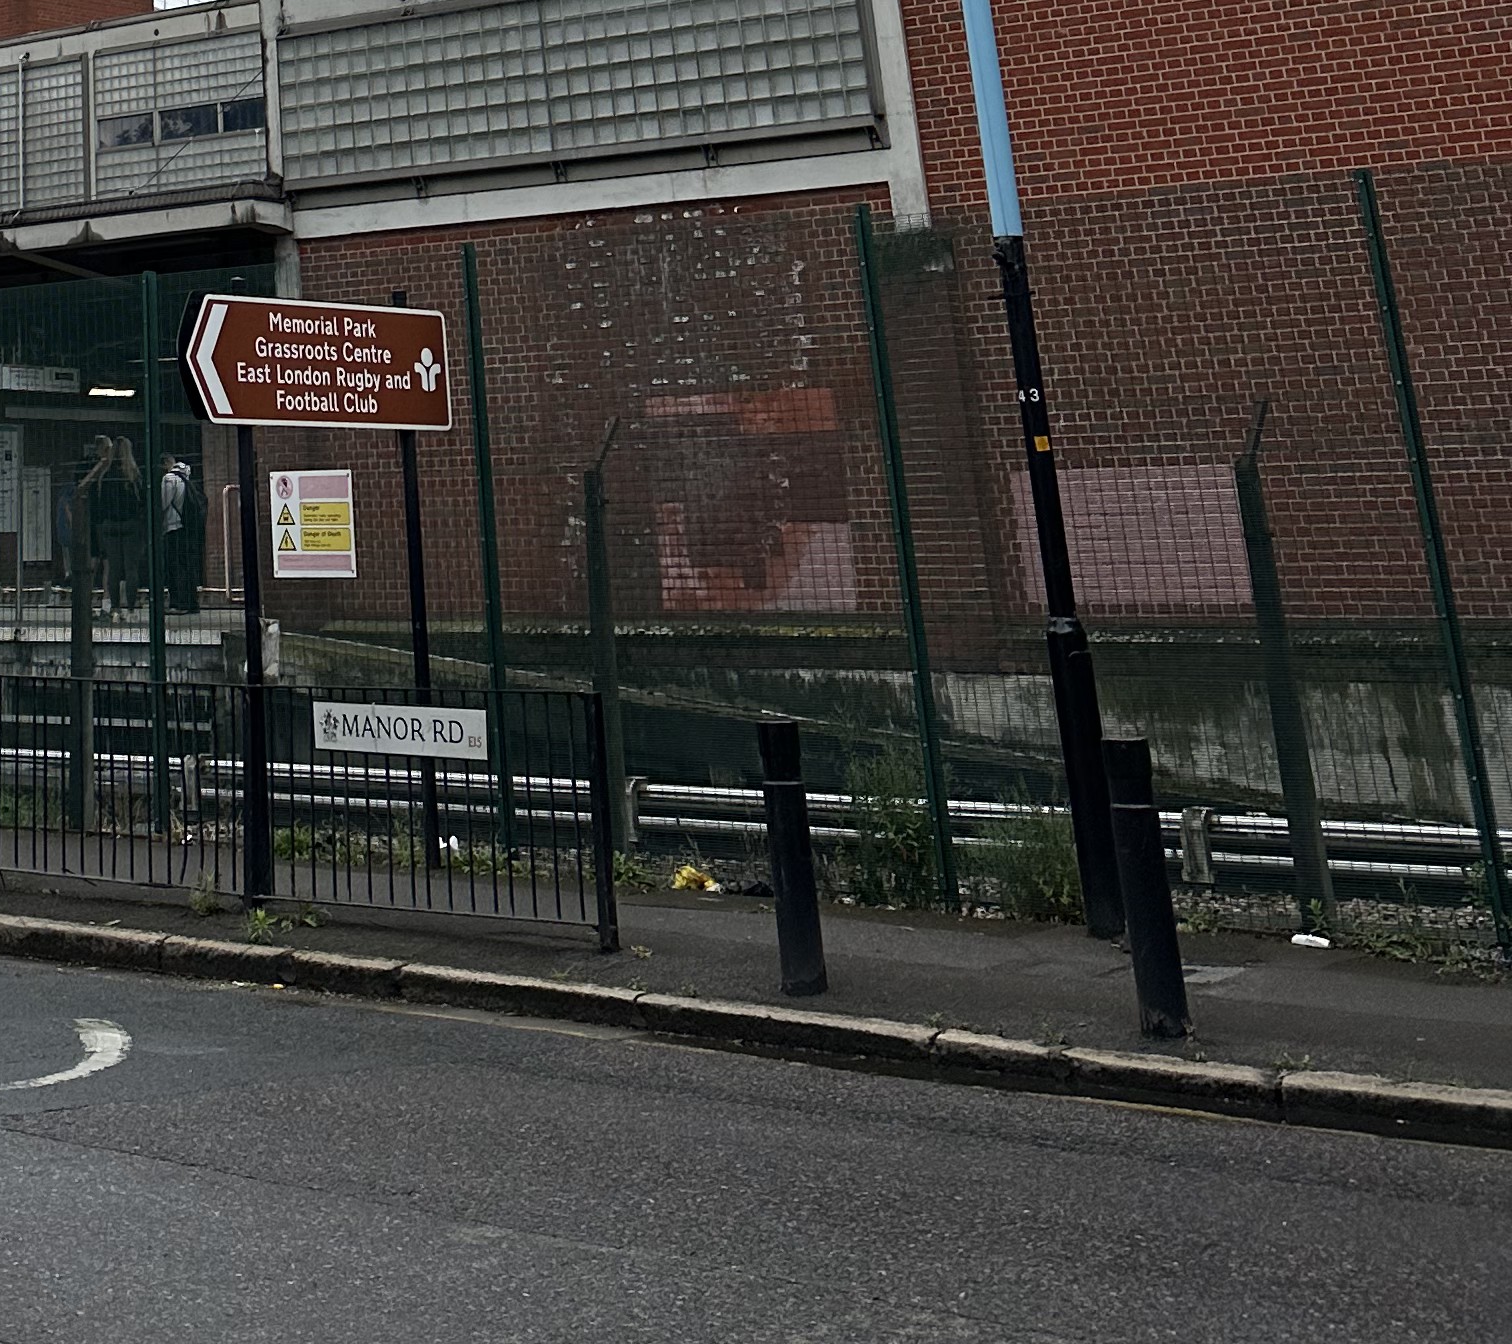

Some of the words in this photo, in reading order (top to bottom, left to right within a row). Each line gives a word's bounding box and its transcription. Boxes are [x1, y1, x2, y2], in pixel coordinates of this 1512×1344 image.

[269, 311, 340, 338] Memorial
[344, 317, 377, 339] Park
[255, 336, 338, 362] Grassroots
[342, 342, 392, 364] Centre
[236, 362, 271, 384] East
[276, 365, 331, 387] London
[335, 367, 381, 393] Rugby
[385, 370, 412, 390] and
[276, 389, 340, 413] Football
[343, 393, 379, 414] Club
[342, 713, 425, 742] MANOR
[432, 719, 464, 744] RD
[468, 735, 483, 748] E15
